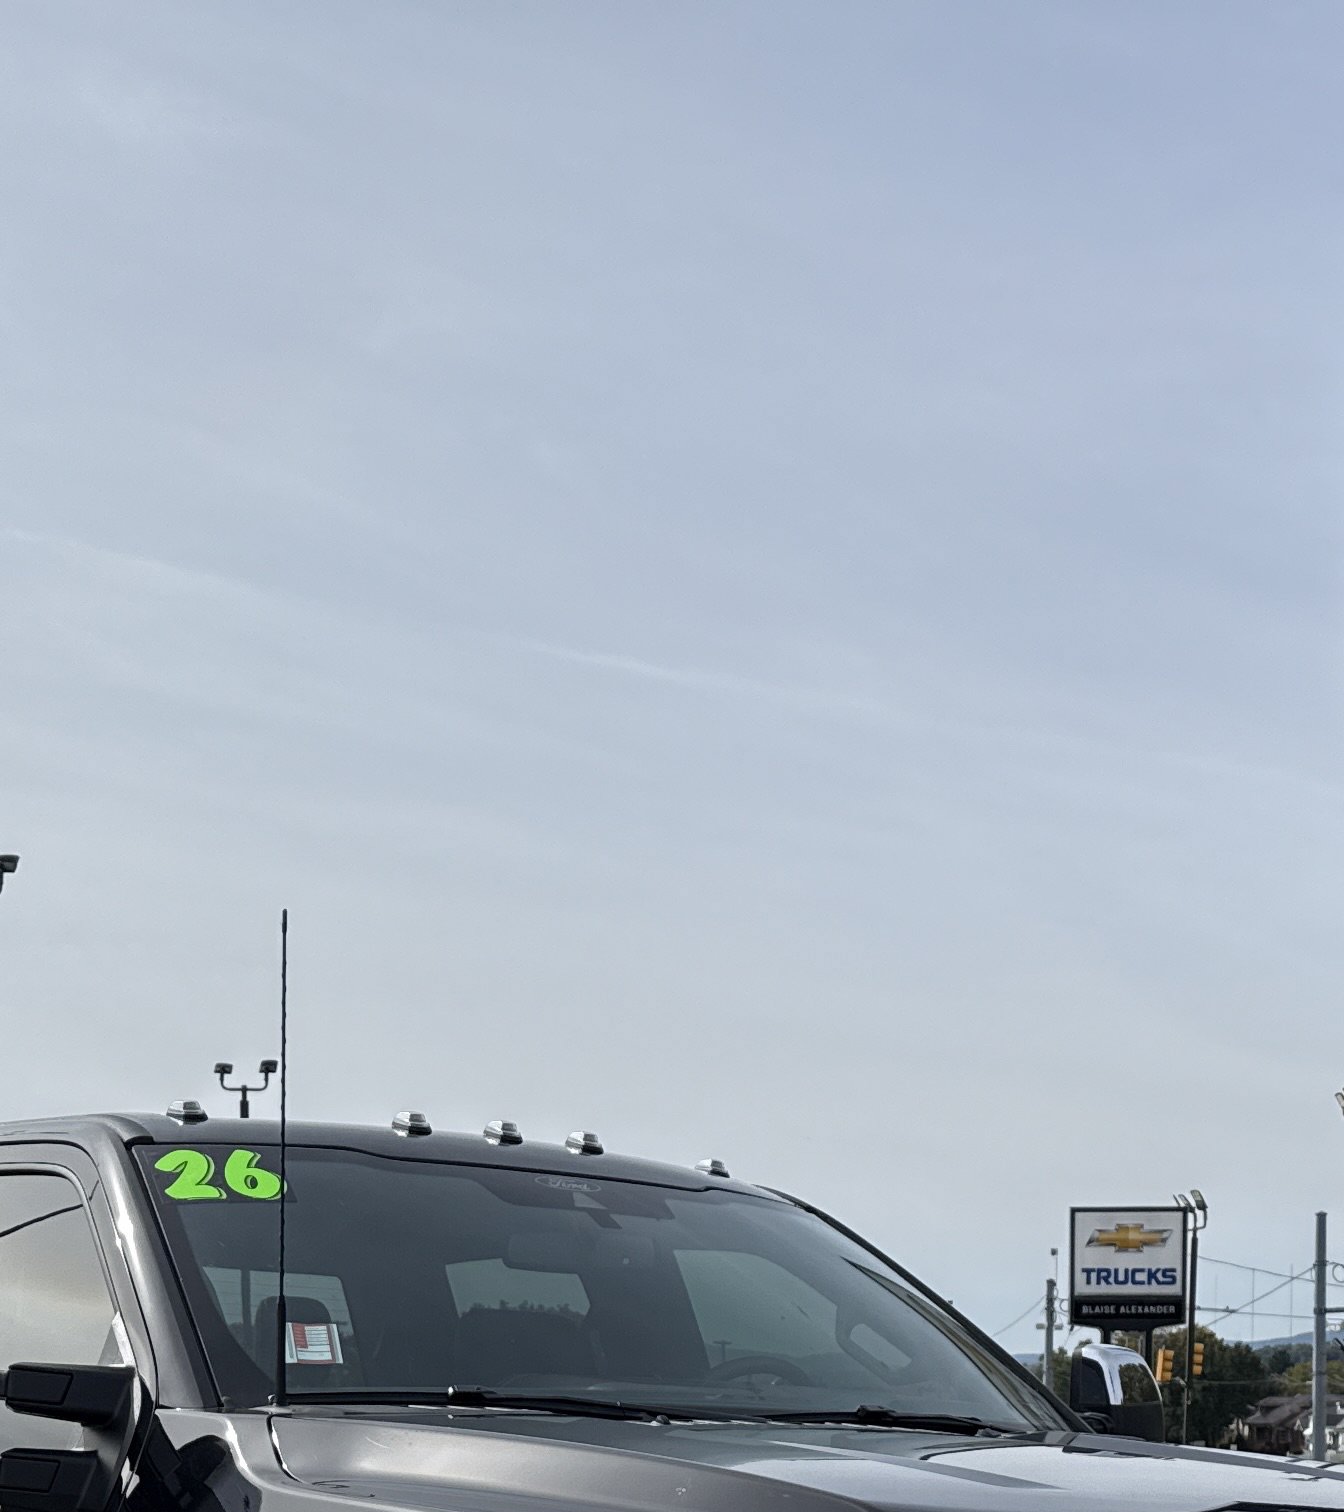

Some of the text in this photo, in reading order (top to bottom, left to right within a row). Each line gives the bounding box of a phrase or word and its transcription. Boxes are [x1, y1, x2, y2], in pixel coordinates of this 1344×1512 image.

[154, 1148, 288, 1201] 26
[1081, 1267, 1177, 1286] TRUCKS
[1081, 1304, 1175, 1314] BLAISE ALEXANDER
